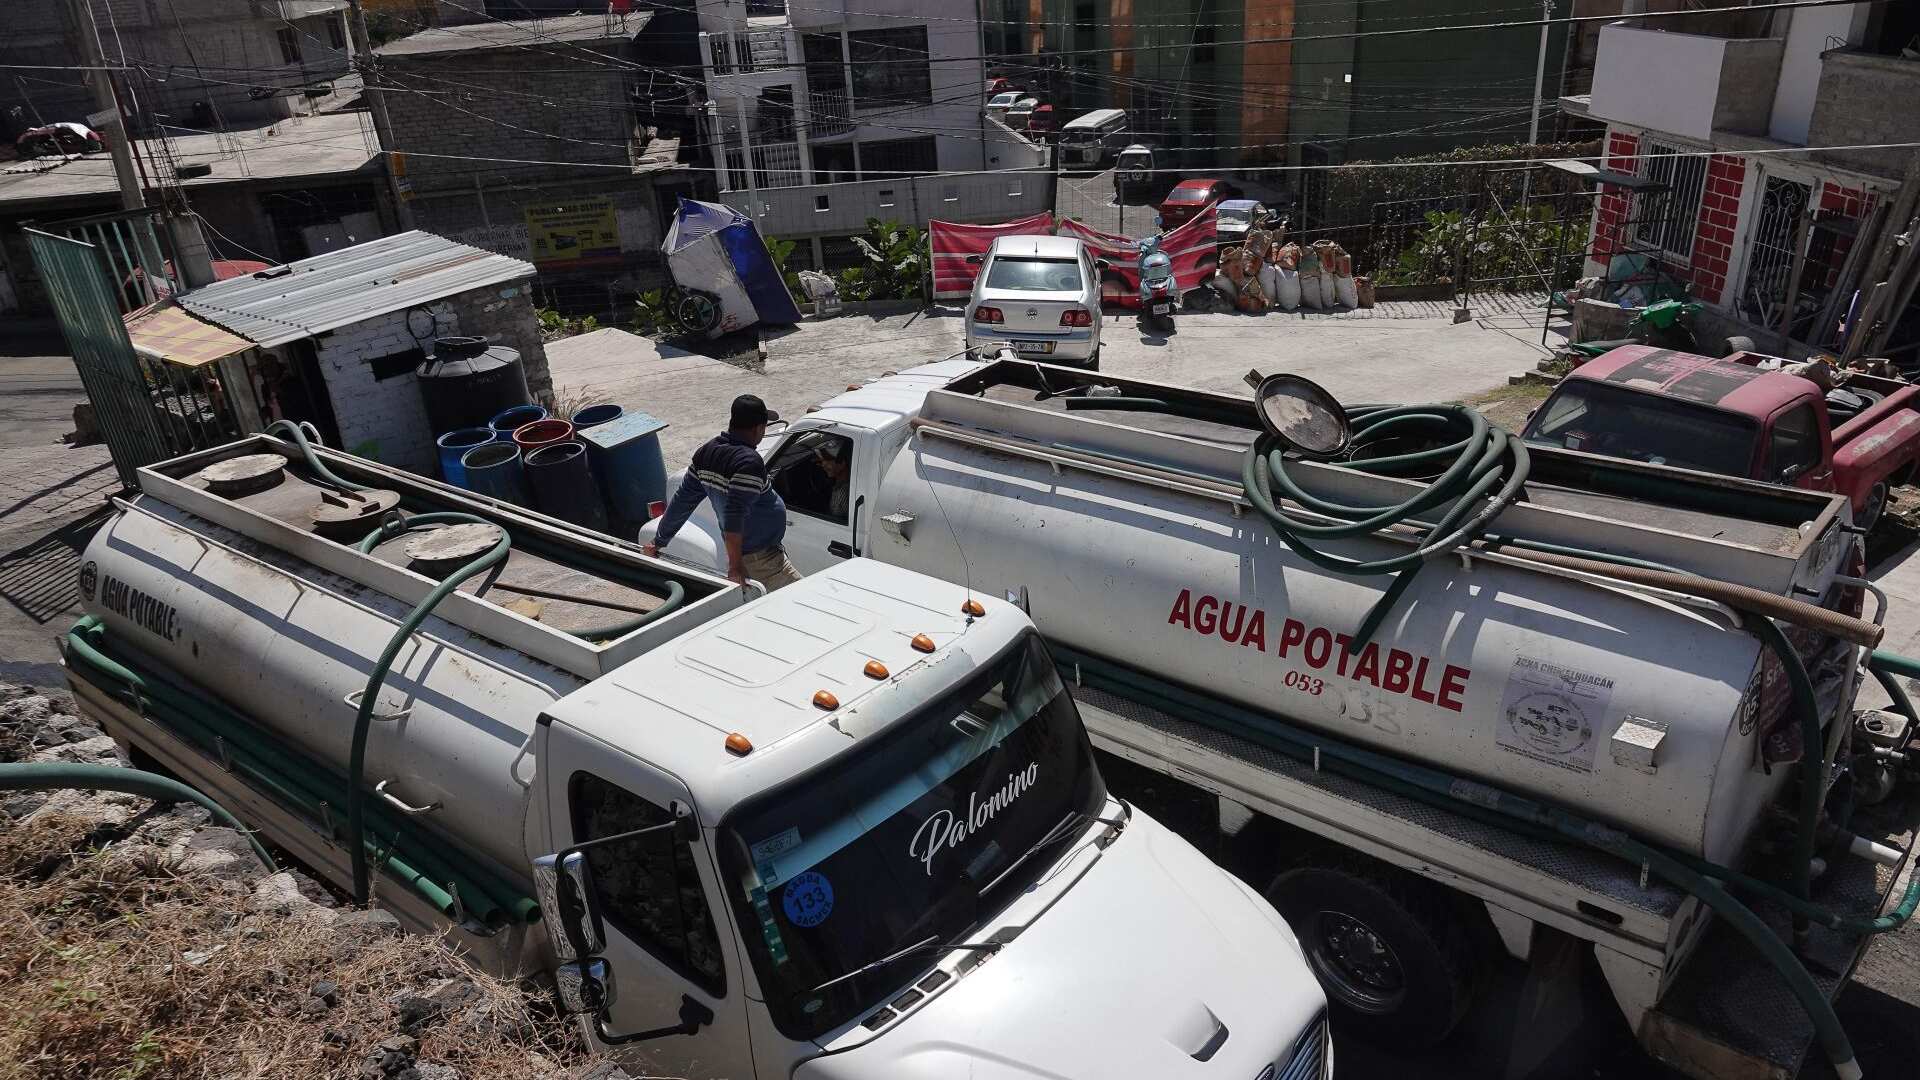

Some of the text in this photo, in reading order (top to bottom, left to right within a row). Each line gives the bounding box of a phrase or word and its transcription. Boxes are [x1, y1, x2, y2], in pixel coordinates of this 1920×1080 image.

[102, 575, 176, 642] AGUA POTABLE
[1168, 589, 1471, 712] AGUA POTABLE
[1284, 670, 1324, 696] 053
[910, 762, 1038, 876] Palomino
[793, 886, 825, 912] 133
